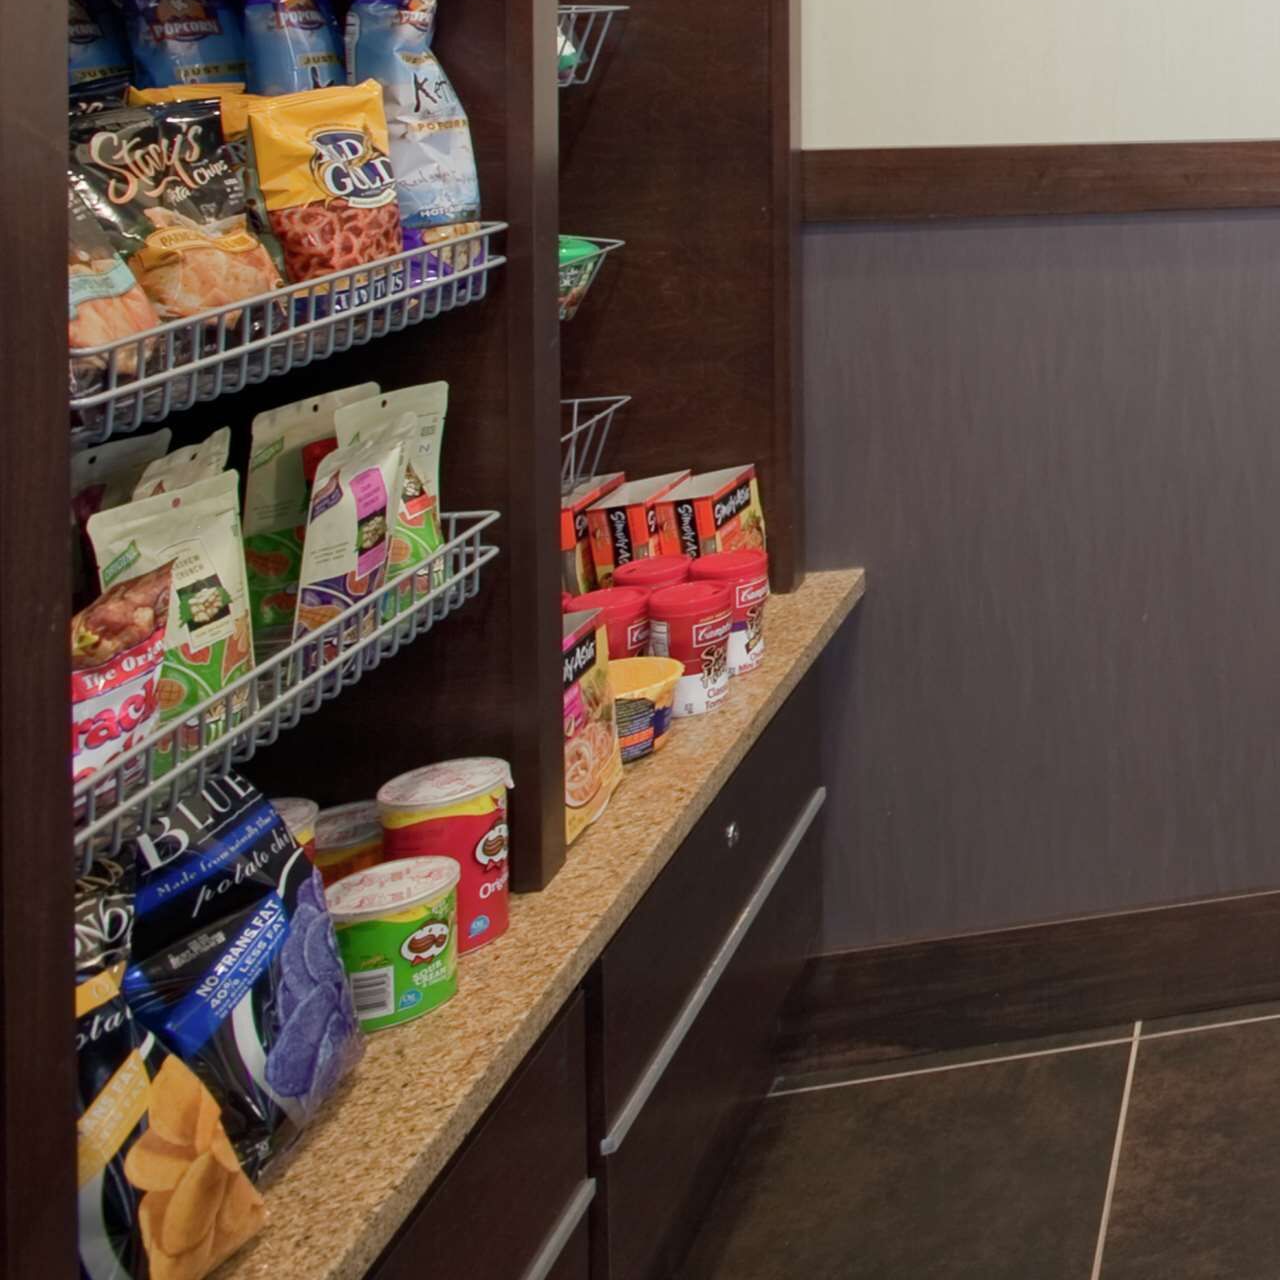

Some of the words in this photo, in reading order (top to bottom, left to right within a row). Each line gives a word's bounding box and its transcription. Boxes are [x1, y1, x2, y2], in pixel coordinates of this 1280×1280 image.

[152, 18, 221, 38] POPCORN
[90, 122, 203, 204] Stacy's
[136, 775, 256, 876] BLUE
[156, 870, 198, 897] Made
[192, 850, 270, 918] potato
[195, 975, 220, 998] NO
[214, 927, 259, 977] TRANS
[251, 899, 280, 929] FAT
